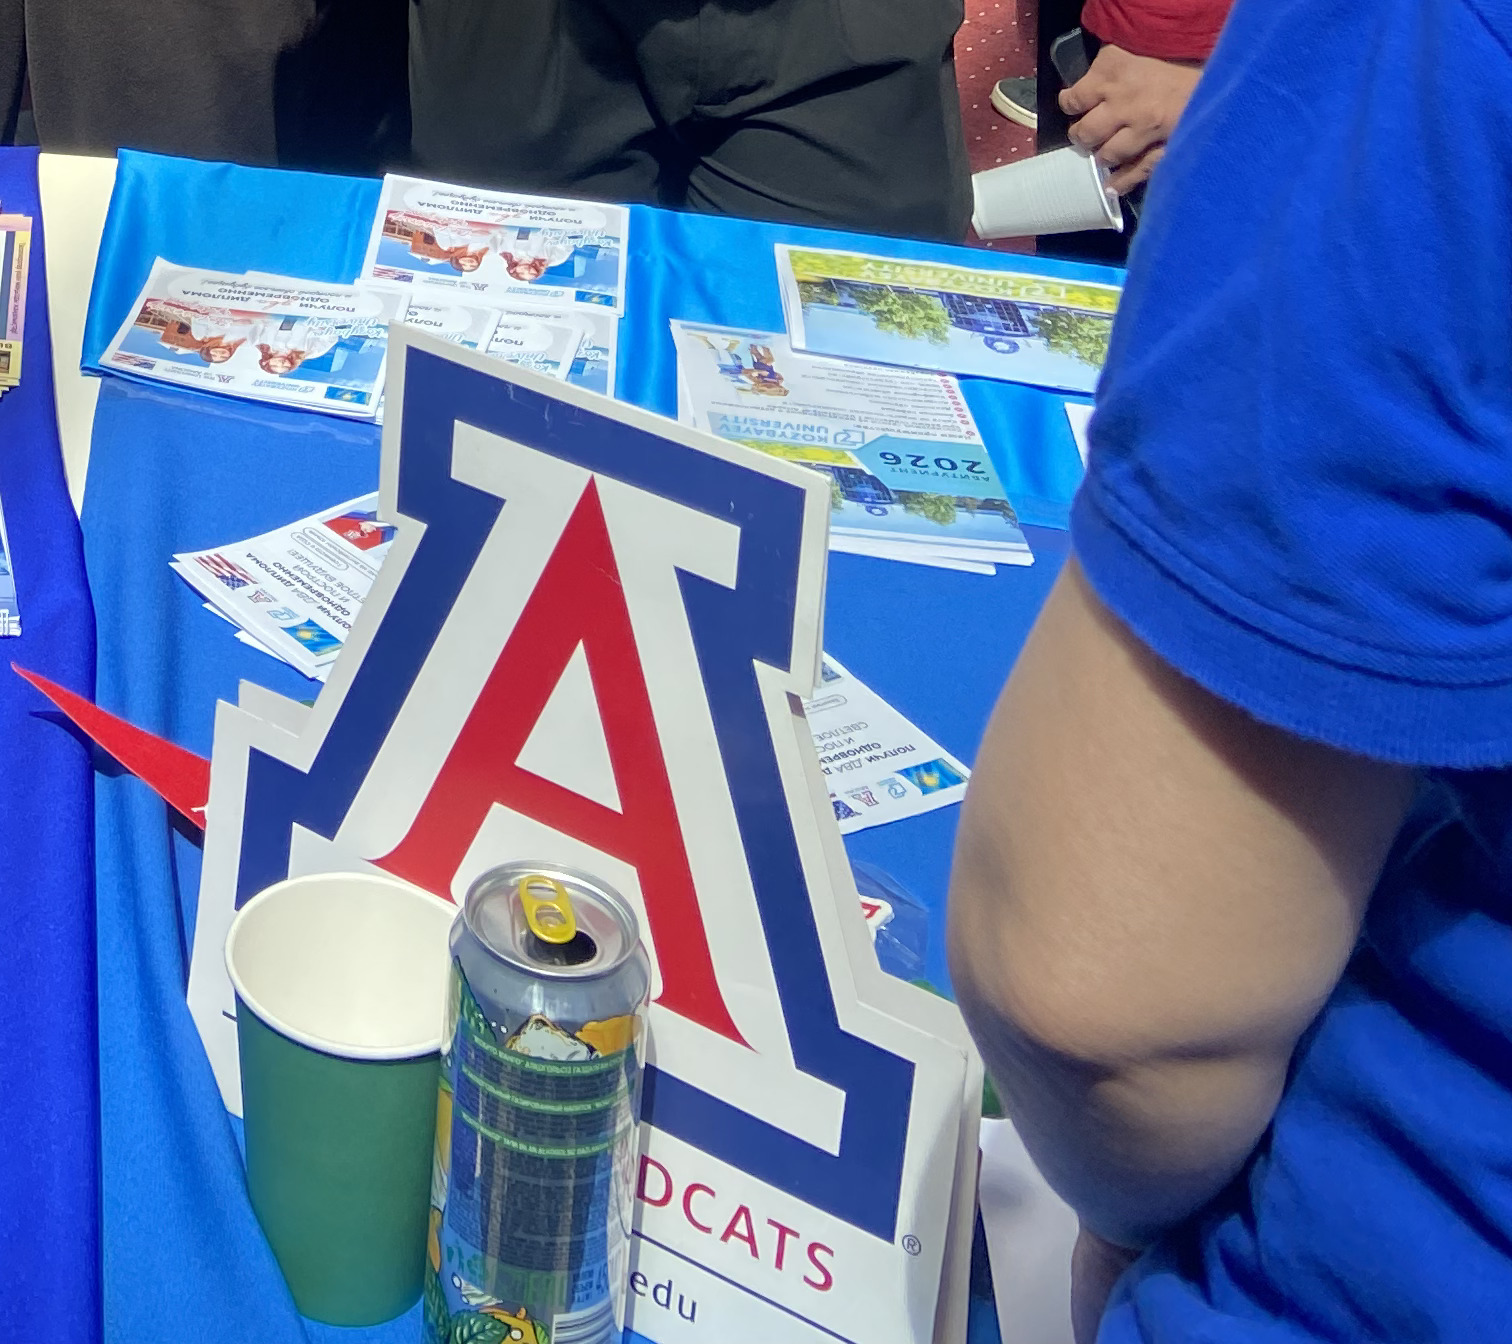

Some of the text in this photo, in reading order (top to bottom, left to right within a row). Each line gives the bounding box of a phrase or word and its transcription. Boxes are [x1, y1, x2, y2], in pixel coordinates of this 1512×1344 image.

[719, 414, 830, 434] UNIVERSITY
[719, 424, 828, 444] KOZYBAYEV
[879, 451, 986, 474] 2026
[245, 551, 295, 588] ДИПЛОМА
[272, 561, 351, 617] ОДНОВРЕМЕННО
[865, 743, 917, 763] ПОЛУЧИ
[636, 1153, 835, 1293] DCATS
[629, 1269, 698, 1324] edu
